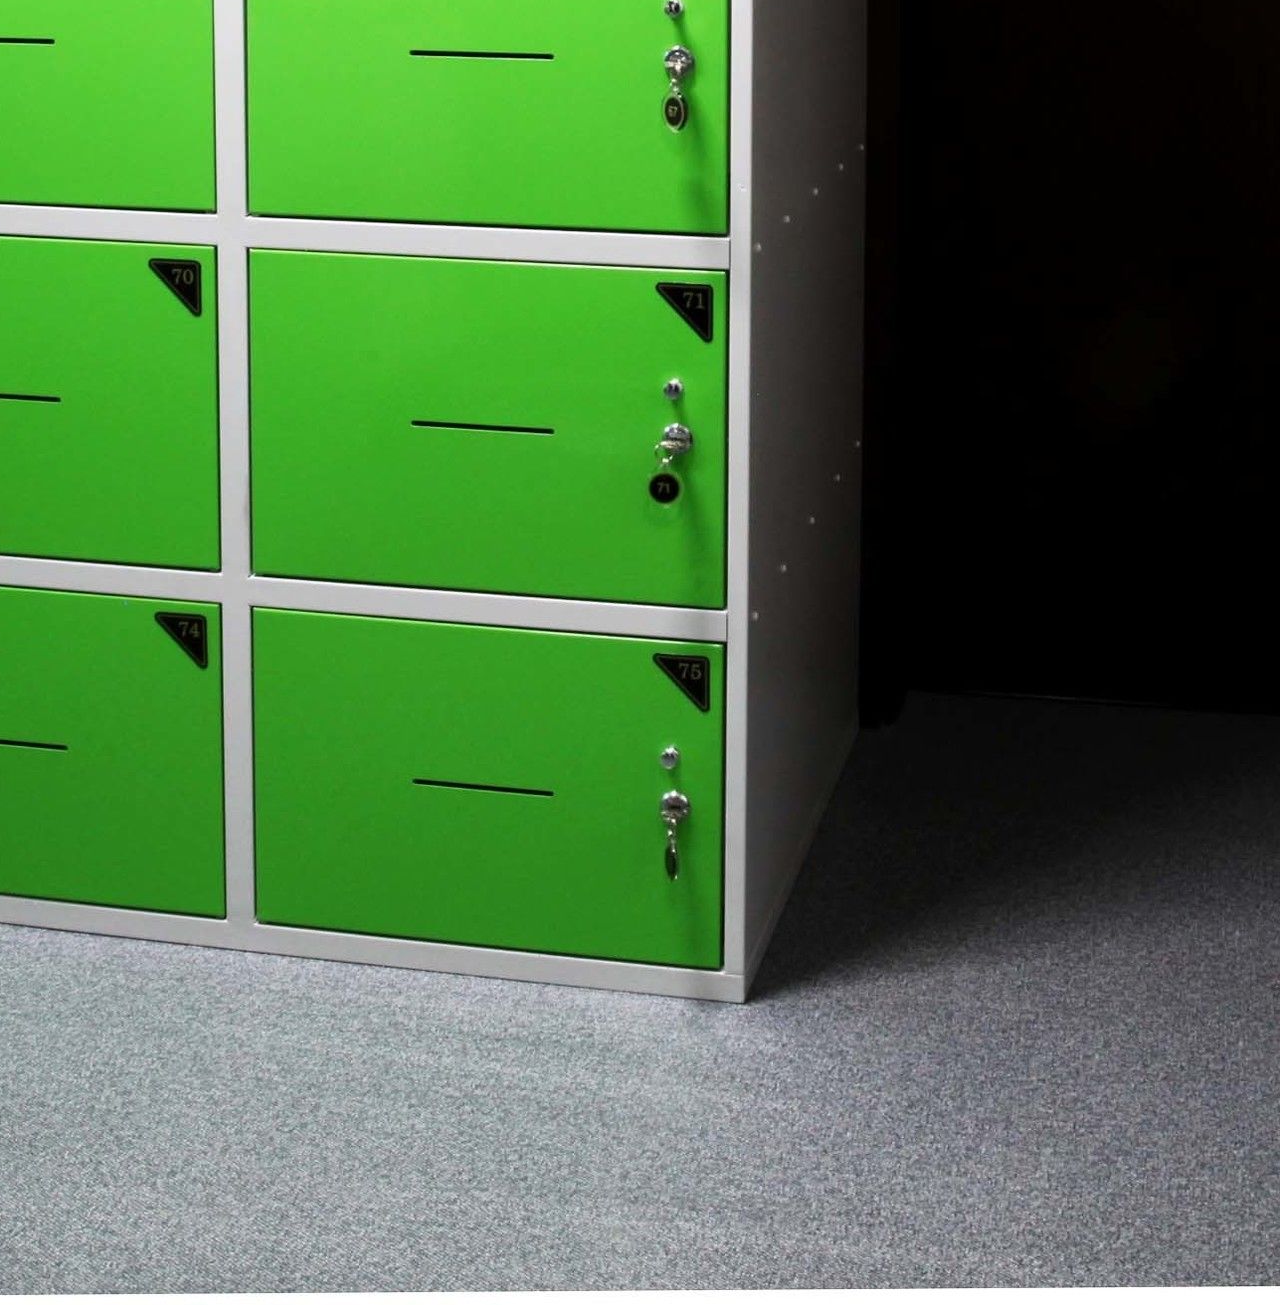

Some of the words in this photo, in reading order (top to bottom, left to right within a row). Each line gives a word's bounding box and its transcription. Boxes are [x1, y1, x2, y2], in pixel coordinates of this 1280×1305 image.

[171, 268, 194, 286] 70
[684, 292, 705, 310] 71
[656, 481, 671, 494] 71
[178, 621, 200, 637] 74
[679, 663, 702, 681] 75
